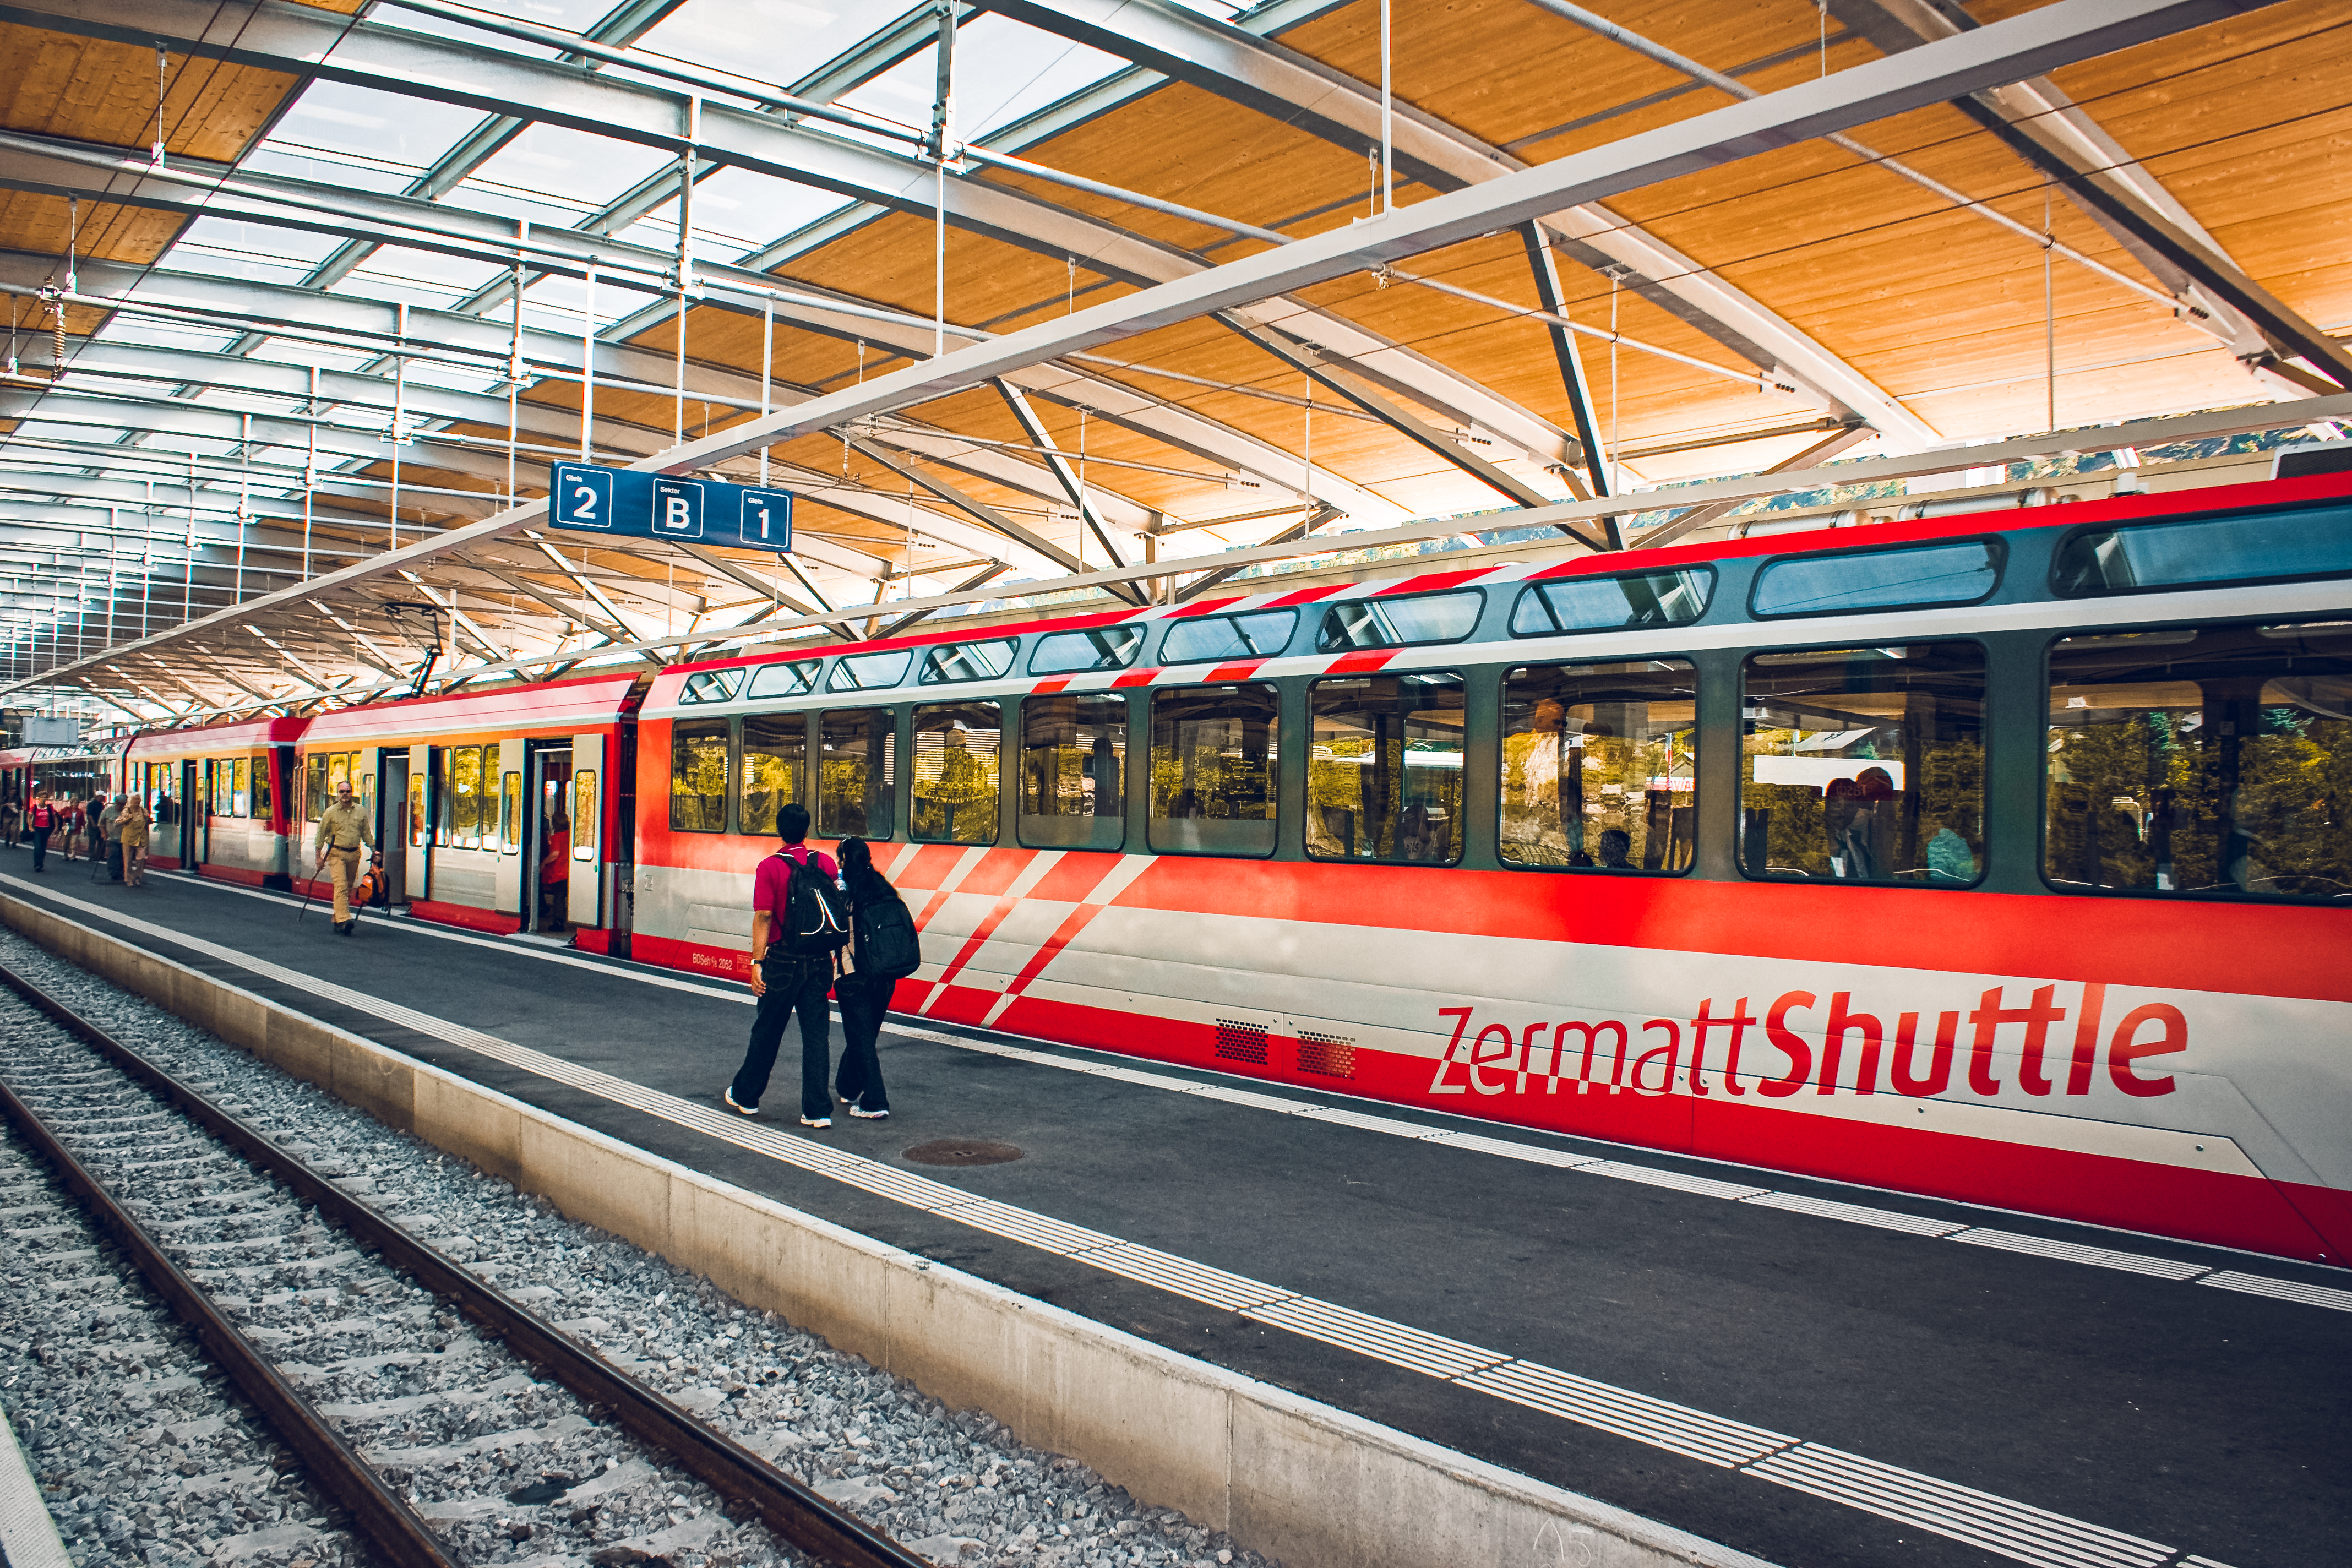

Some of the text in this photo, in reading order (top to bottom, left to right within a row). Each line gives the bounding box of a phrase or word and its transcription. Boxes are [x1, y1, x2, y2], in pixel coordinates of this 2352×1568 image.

[565, 474, 583, 482] Gleis
[660, 486, 680, 494] Sektor
[573, 486, 597, 519] 2
[666, 497, 690, 529] B
[748, 497, 763, 505] Gleis
[758, 508, 770, 538] 1
[1428, 982, 2188, 1098] ZermattShuttle
